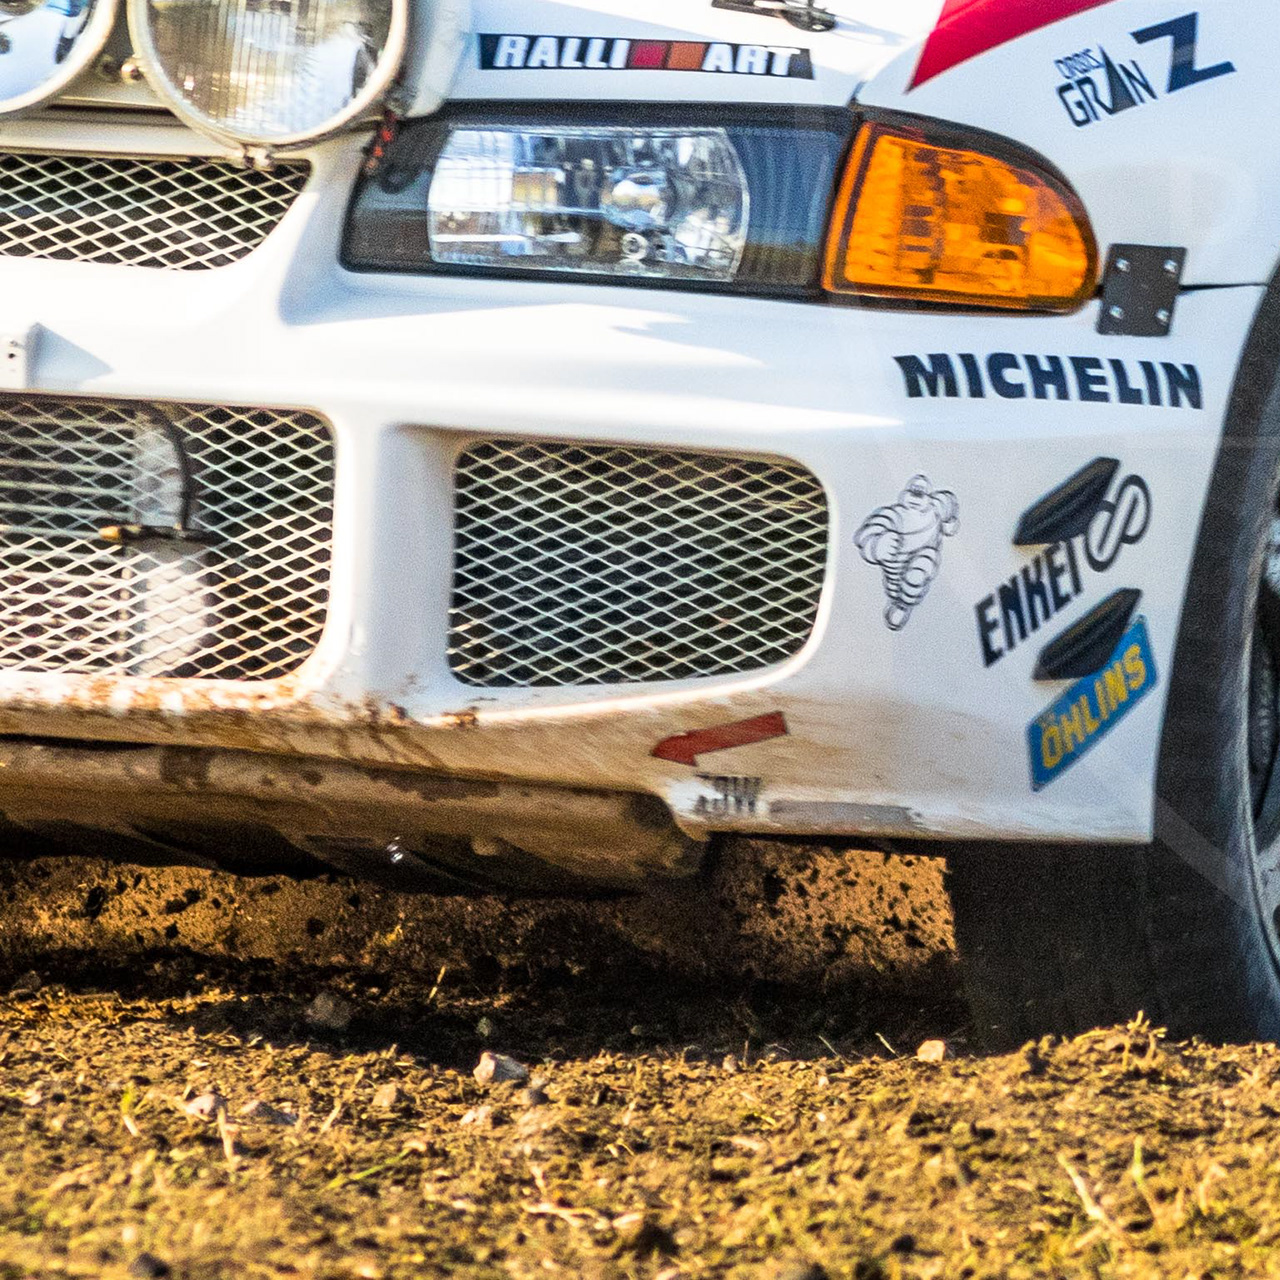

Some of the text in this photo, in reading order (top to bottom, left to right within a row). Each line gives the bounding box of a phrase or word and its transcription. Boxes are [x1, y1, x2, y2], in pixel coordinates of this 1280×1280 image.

[492, 35, 801, 76] RALLI ART
[1129, 11, 1238, 95] Z
[892, 352, 1204, 410] MICHELIN
[974, 537, 1084, 669] ENKEI
[1040, 642, 1148, 770] ÖHLINS
